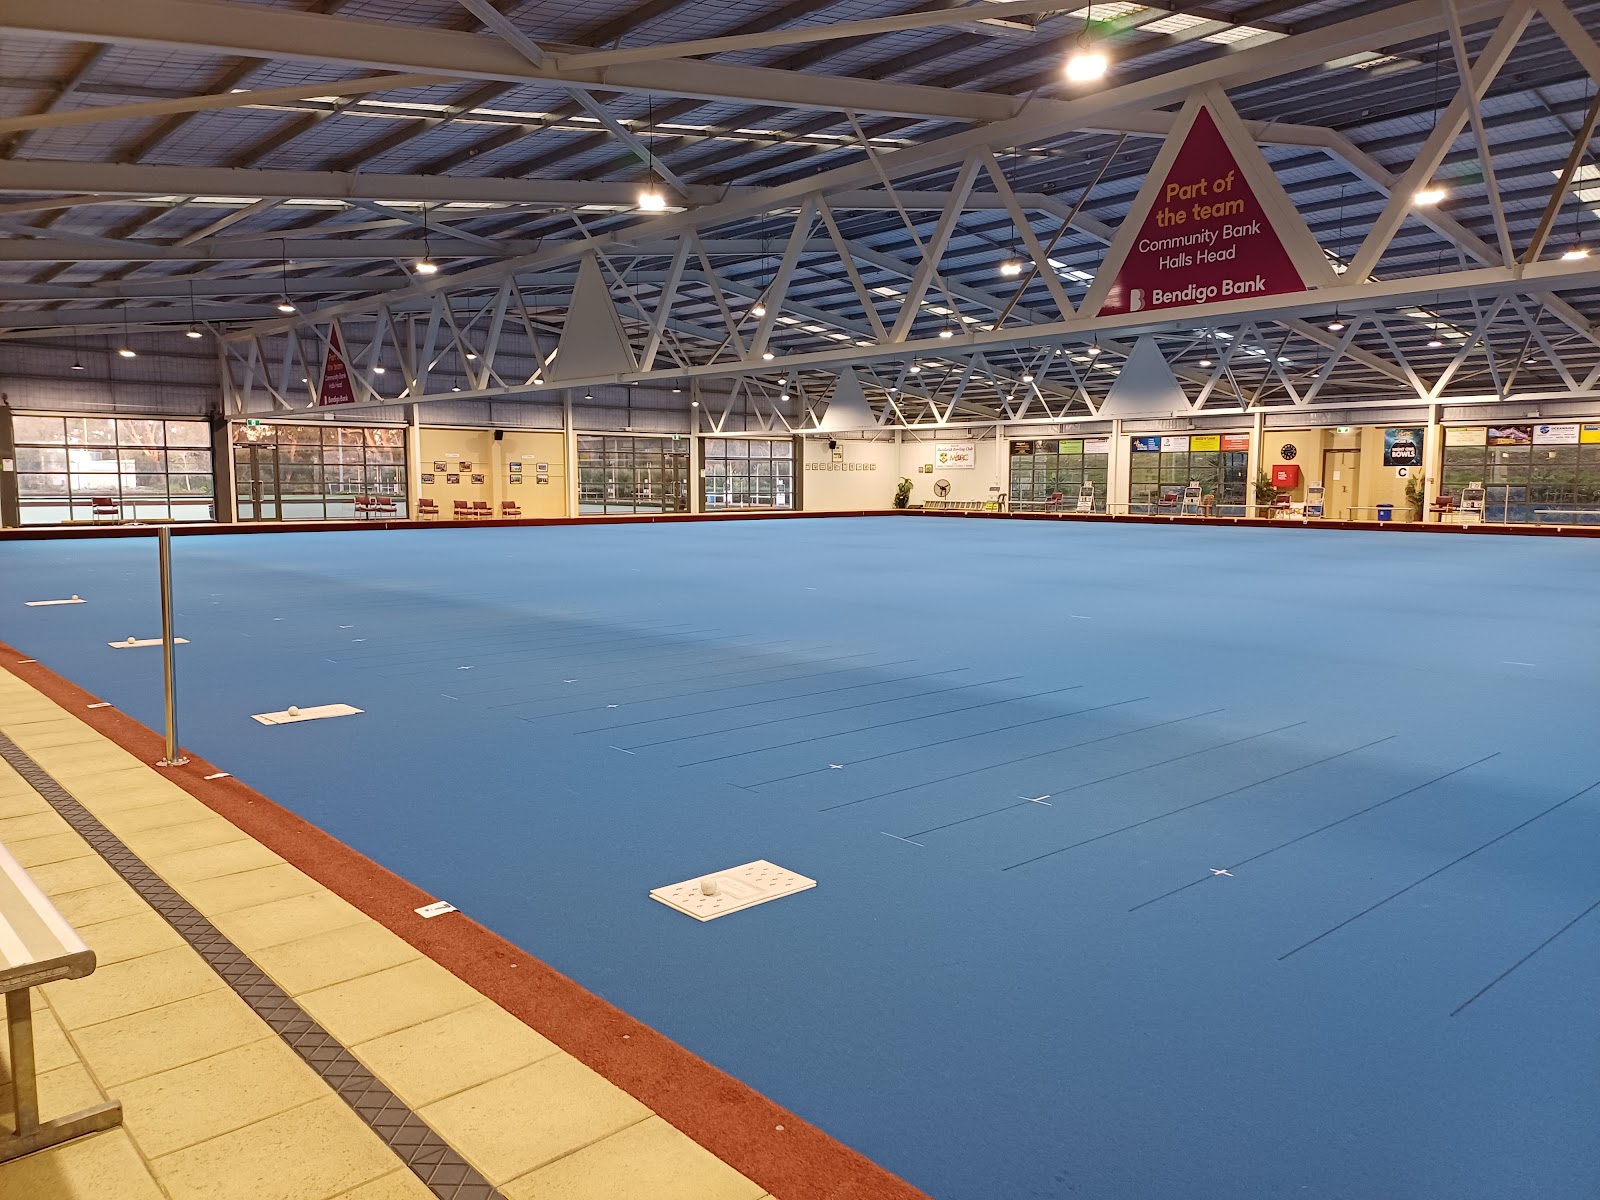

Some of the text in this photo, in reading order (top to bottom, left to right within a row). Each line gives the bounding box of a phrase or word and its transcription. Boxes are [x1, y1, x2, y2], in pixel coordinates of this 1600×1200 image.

[1166, 170, 1235, 203] Part of
[1156, 199, 1245, 228] the team
[1138, 220, 1261, 253] Community Bank
[1159, 244, 1236, 271] Halls Head
[1152, 283, 1218, 305] Bendigo
[1221, 274, 1266, 296] Bank
[1398, 467, 1407, 477] C
